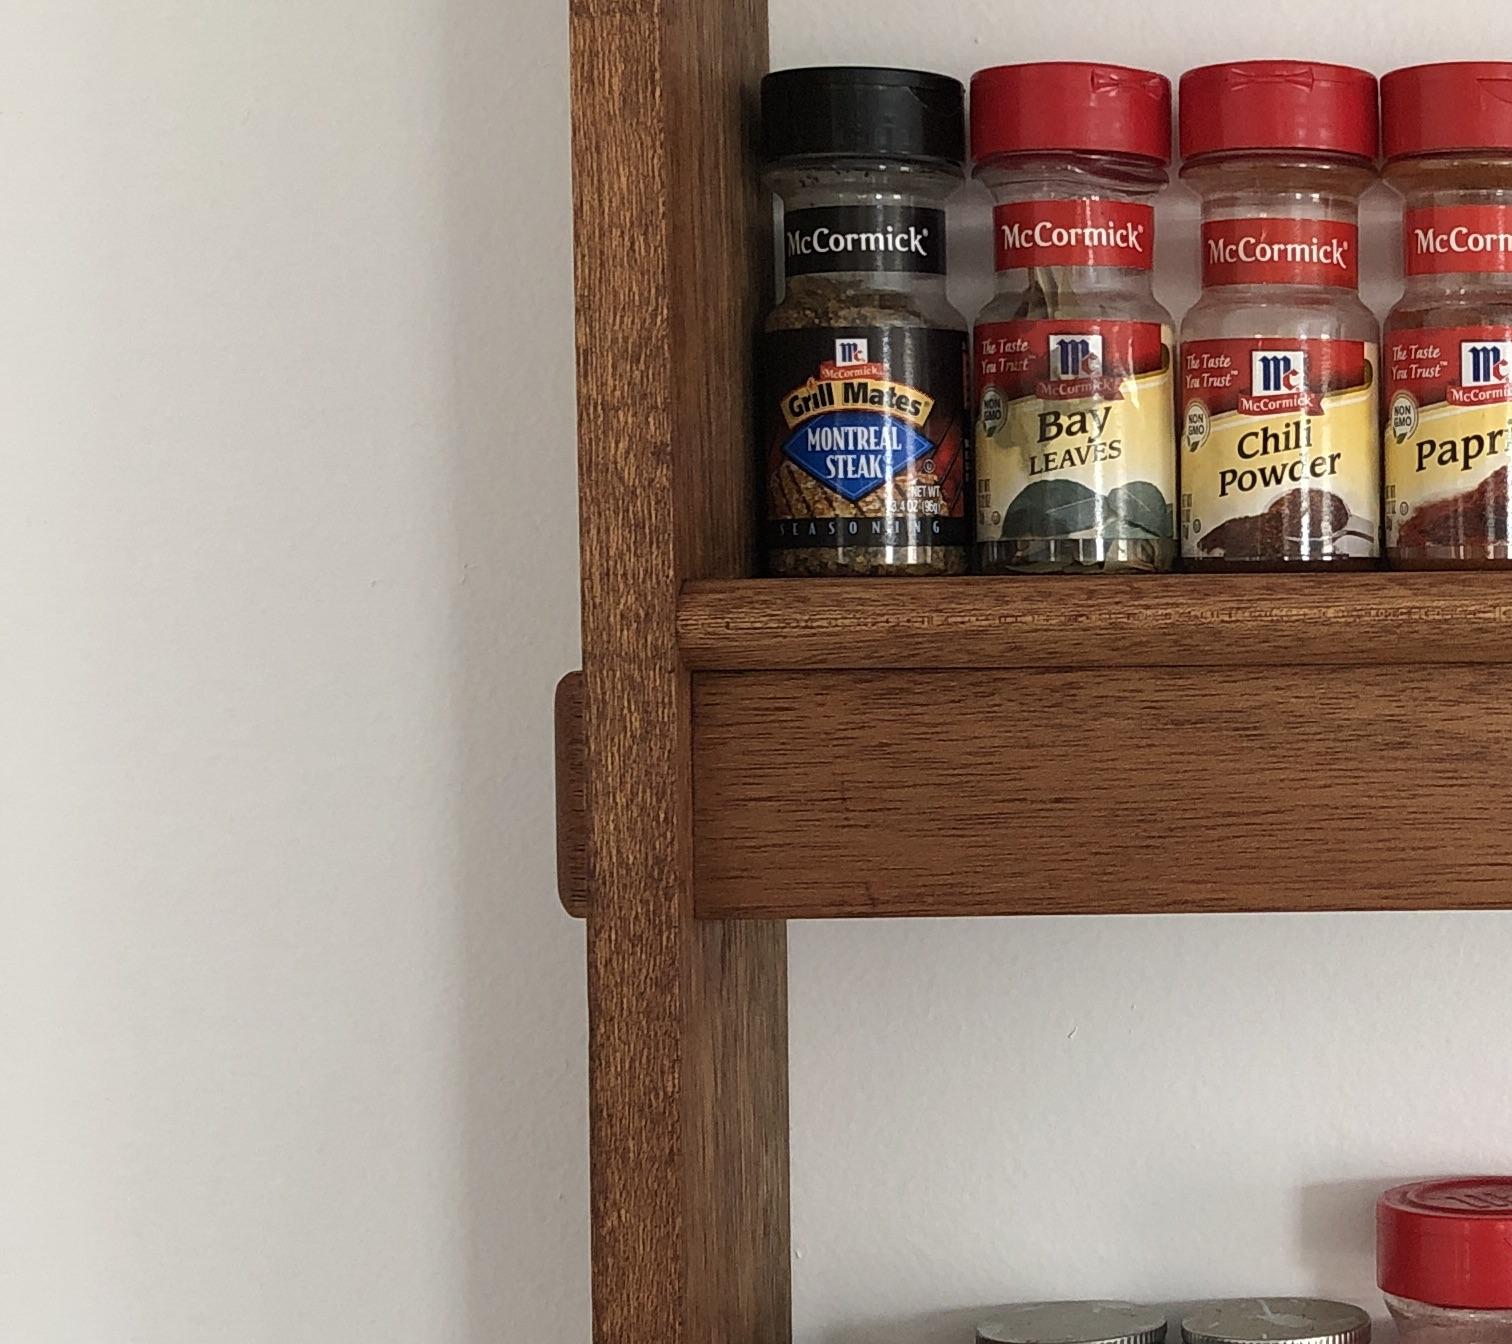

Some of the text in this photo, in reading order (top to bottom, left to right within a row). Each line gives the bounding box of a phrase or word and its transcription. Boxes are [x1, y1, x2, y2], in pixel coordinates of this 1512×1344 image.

[787, 228, 928, 255] McCormick
[1001, 223, 1143, 252] McCormick
[1208, 237, 1346, 268] McCormick
[1409, 345, 1440, 358] Taste
[824, 368, 877, 379] McCormick
[788, 382, 922, 417] Grill Mates
[1241, 394, 1312, 412] McCormick
[1394, 405, 1411, 416] NON
[1037, 406, 1112, 443] Bay
[1188, 414, 1204, 425] NON
[1188, 425, 1204, 436] GMO
[1394, 416, 1412, 428] GMO
[808, 426, 902, 451] MONTREAL
[1238, 419, 1313, 459] Chili
[826, 455, 883, 479] STEAK
[1029, 440, 1121, 476] LEAVES
[1219, 453, 1341, 496] Powder
[928, 485, 940, 497] WT
[907, 500, 918, 512] OZ
